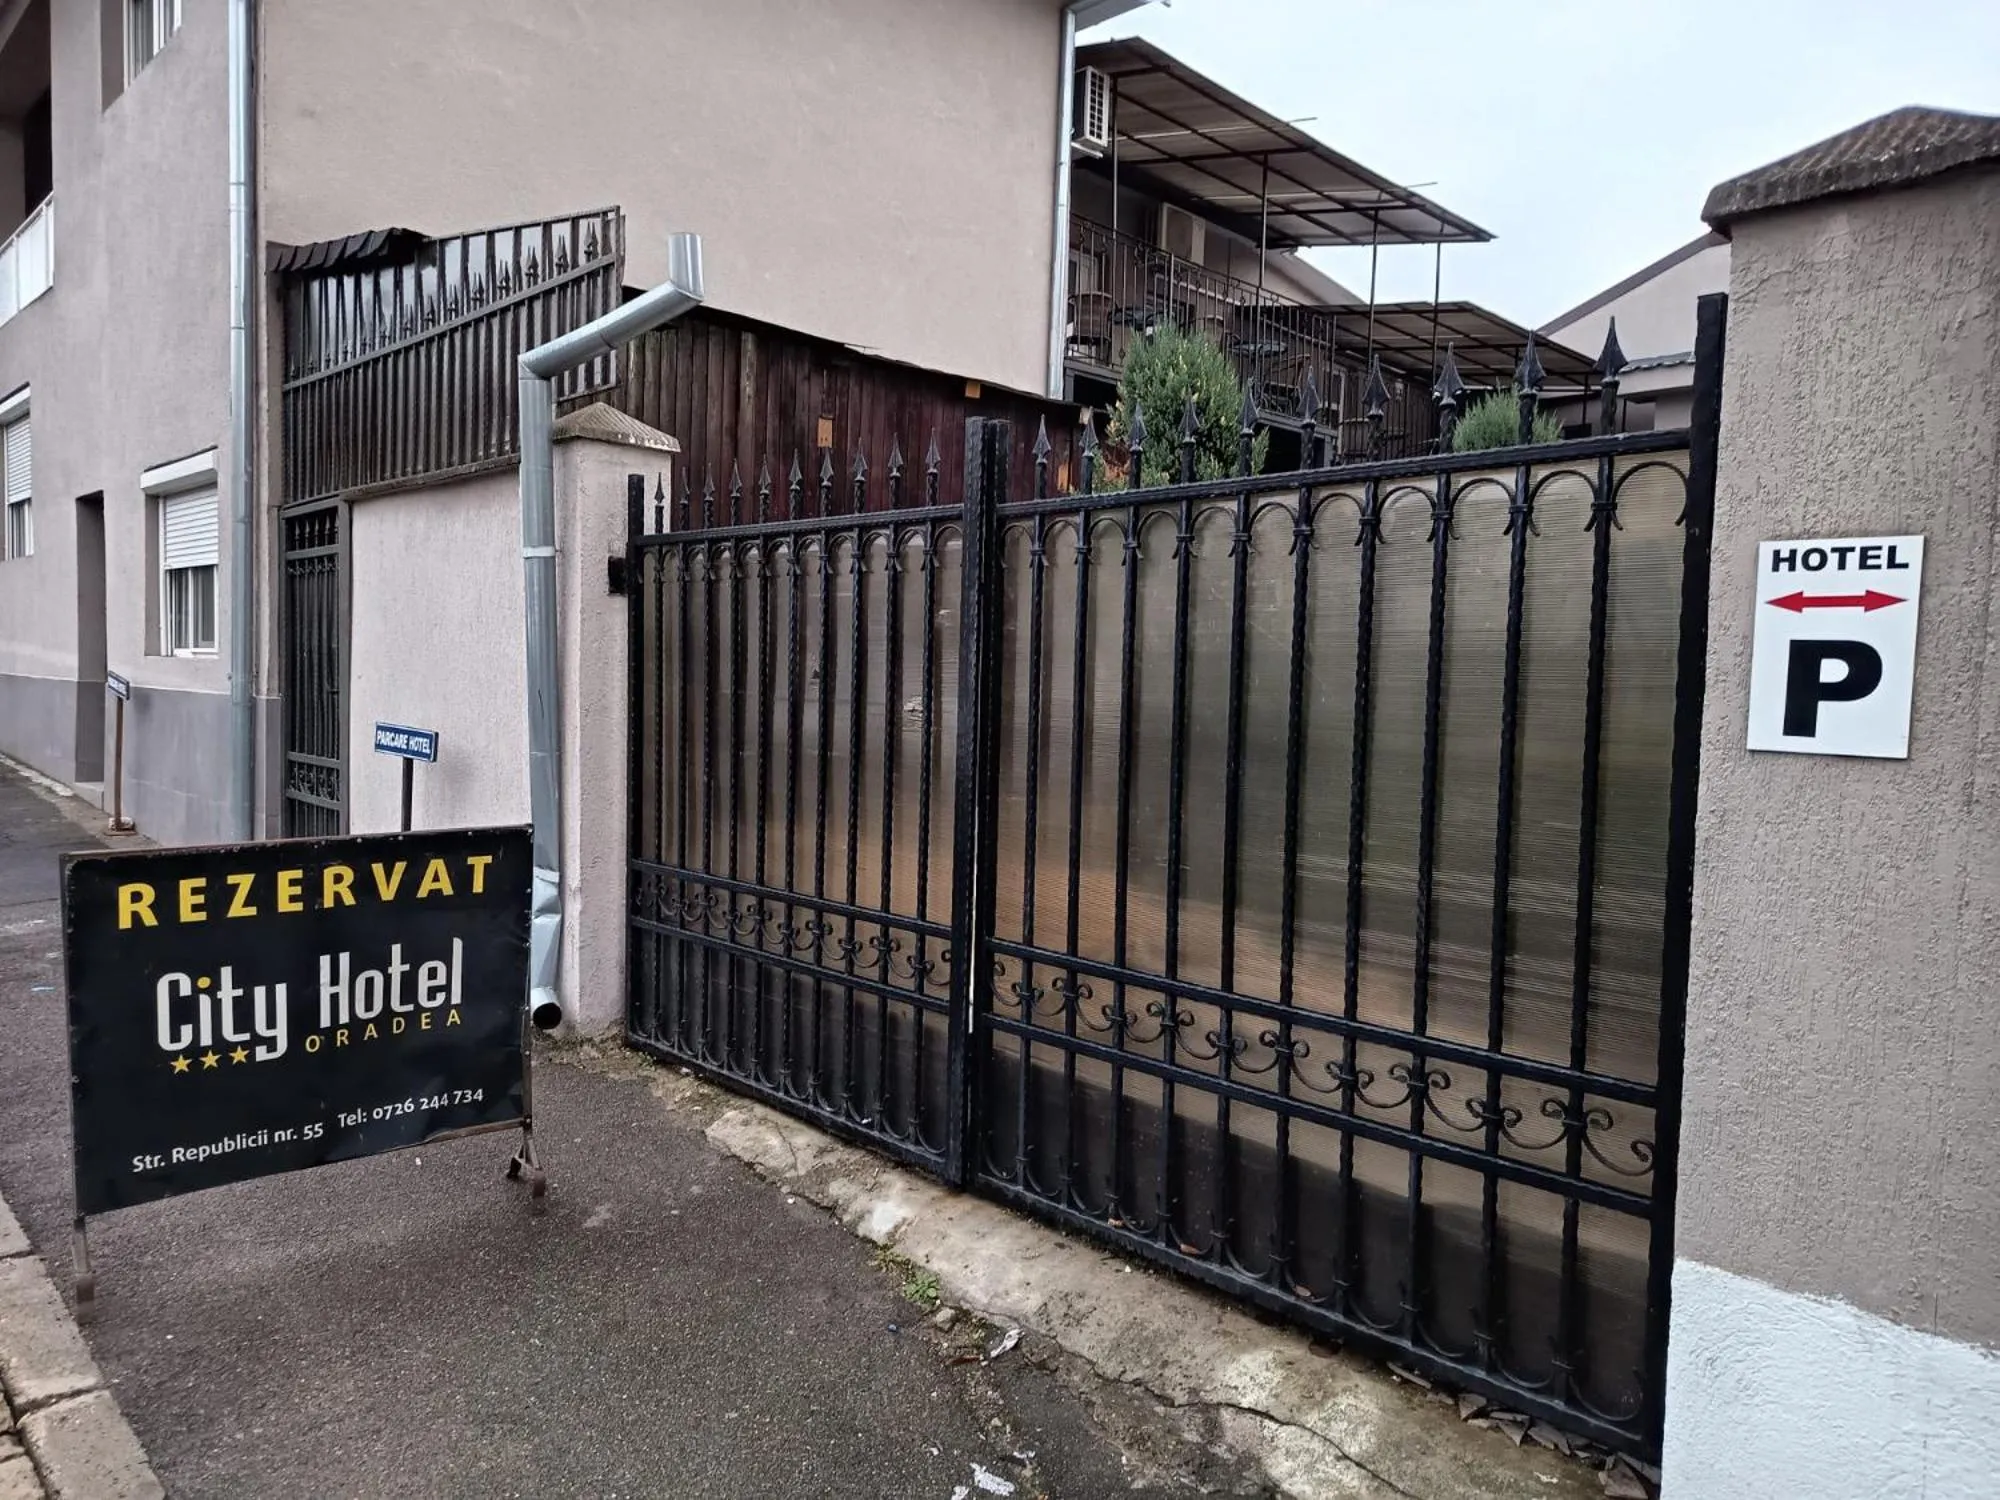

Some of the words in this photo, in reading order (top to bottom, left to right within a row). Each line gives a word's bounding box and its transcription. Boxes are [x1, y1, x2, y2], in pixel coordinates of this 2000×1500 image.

[1771, 545, 1910, 572] HOTEL
[1782, 639, 1883, 738] P
[408, 735, 431, 753] HOTEL
[117, 855, 493, 929] REZERVAT
[156, 966, 288, 1062] City
[319, 937, 463, 1029] Hotel
[305, 1010, 462, 1053] ORADEA
[132, 1154, 166, 1173] Str.
[171, 1129, 269, 1164] Republicii
[274, 1128, 299, 1143] nr.
[303, 1122, 324, 1140] 55
[338, 1108, 368, 1128] Tel:
[372, 1098, 415, 1120] 0726
[420, 1094, 449, 1111] 244
[452, 1088, 484, 1105] 734
